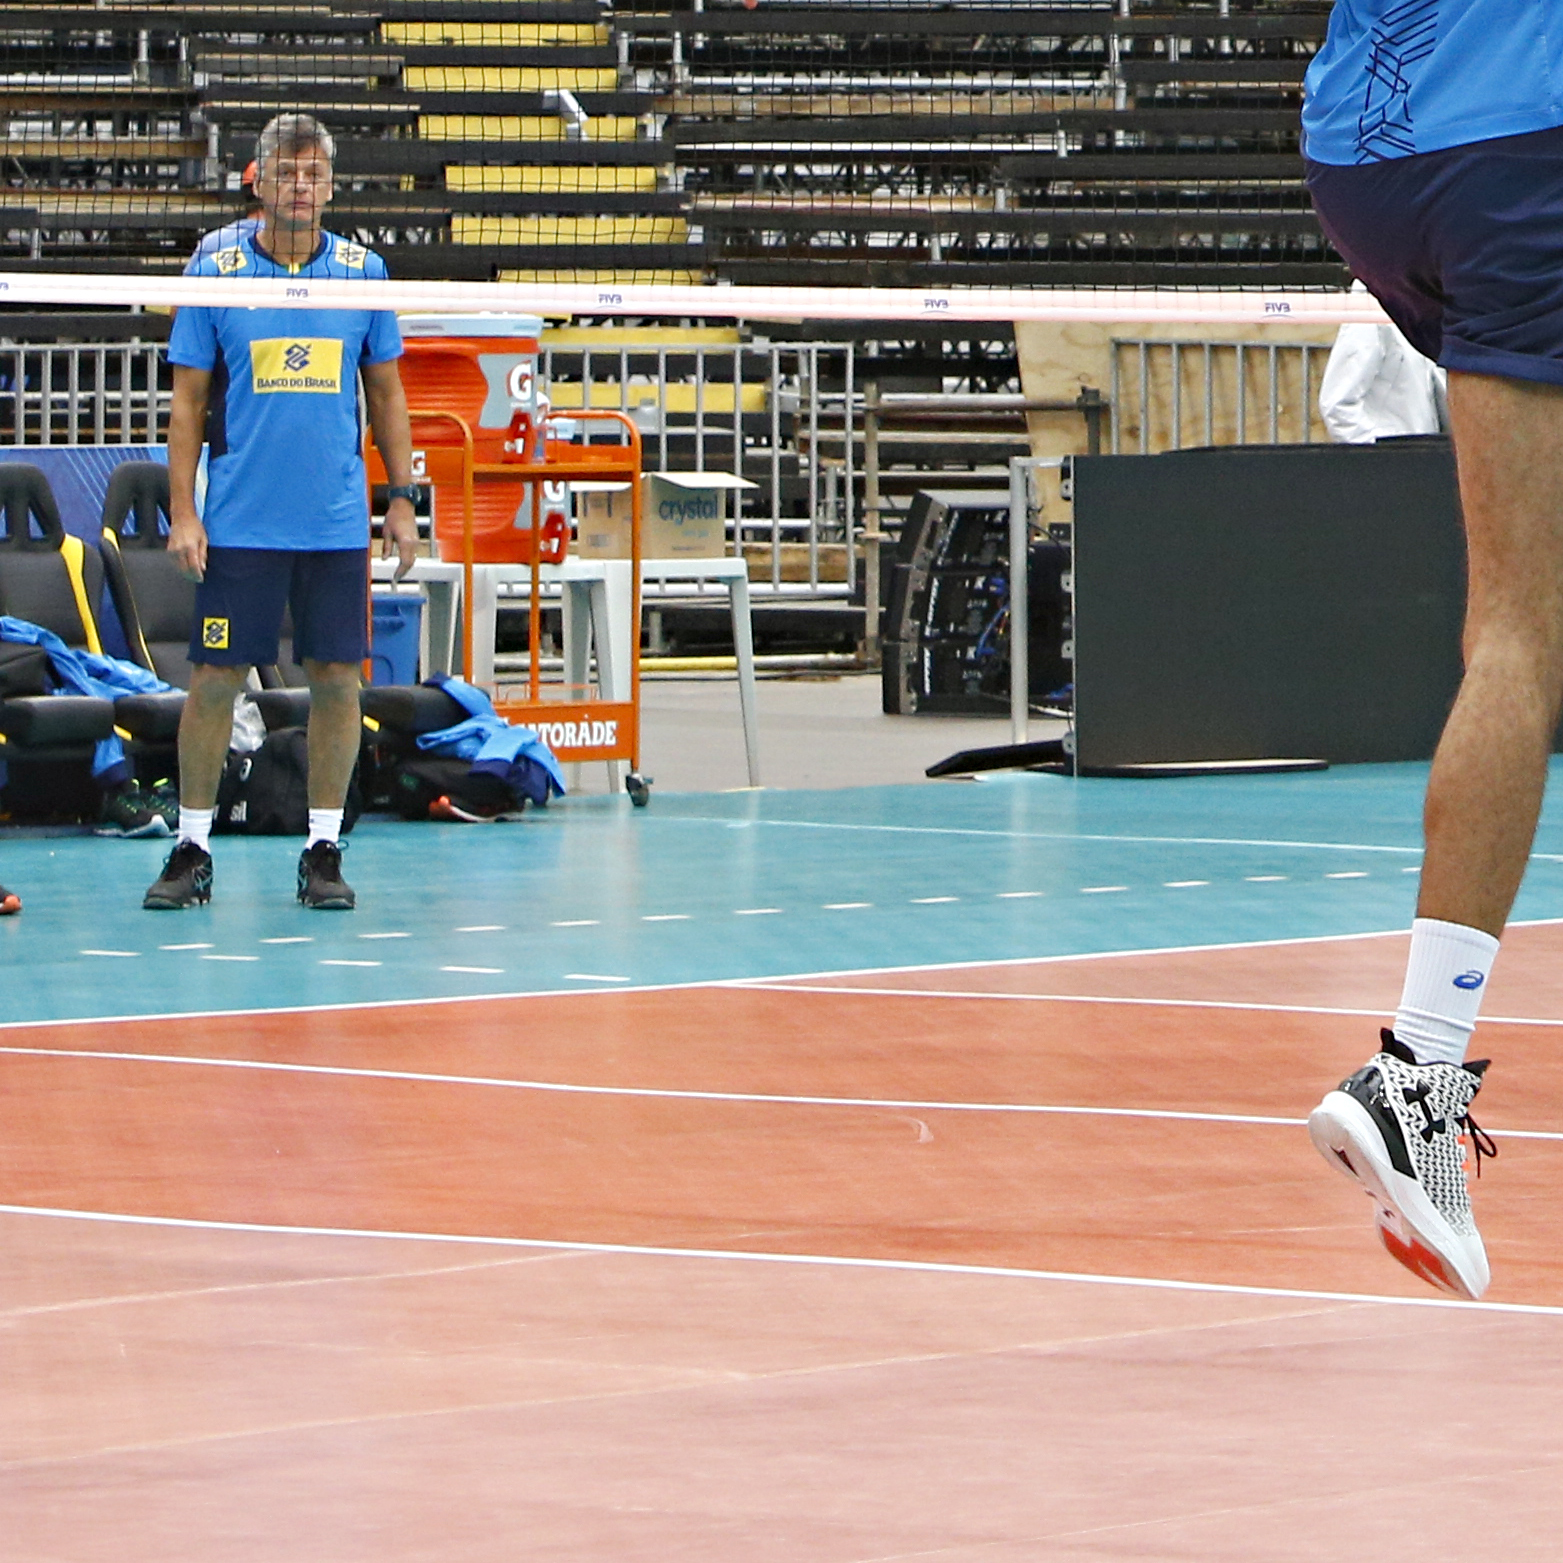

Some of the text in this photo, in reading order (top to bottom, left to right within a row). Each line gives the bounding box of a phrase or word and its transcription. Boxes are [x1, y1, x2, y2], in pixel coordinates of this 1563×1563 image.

[285, 288, 309, 298] FIVB
[598, 294, 623, 305] FIVB
[923, 299, 949, 310] FIVB
[1265, 302, 1292, 313] FIVB
[257, 376, 337, 389] BANCO DO BRASIL
[659, 494, 719, 526] crystal
[519, 720, 617, 748] TORADE
